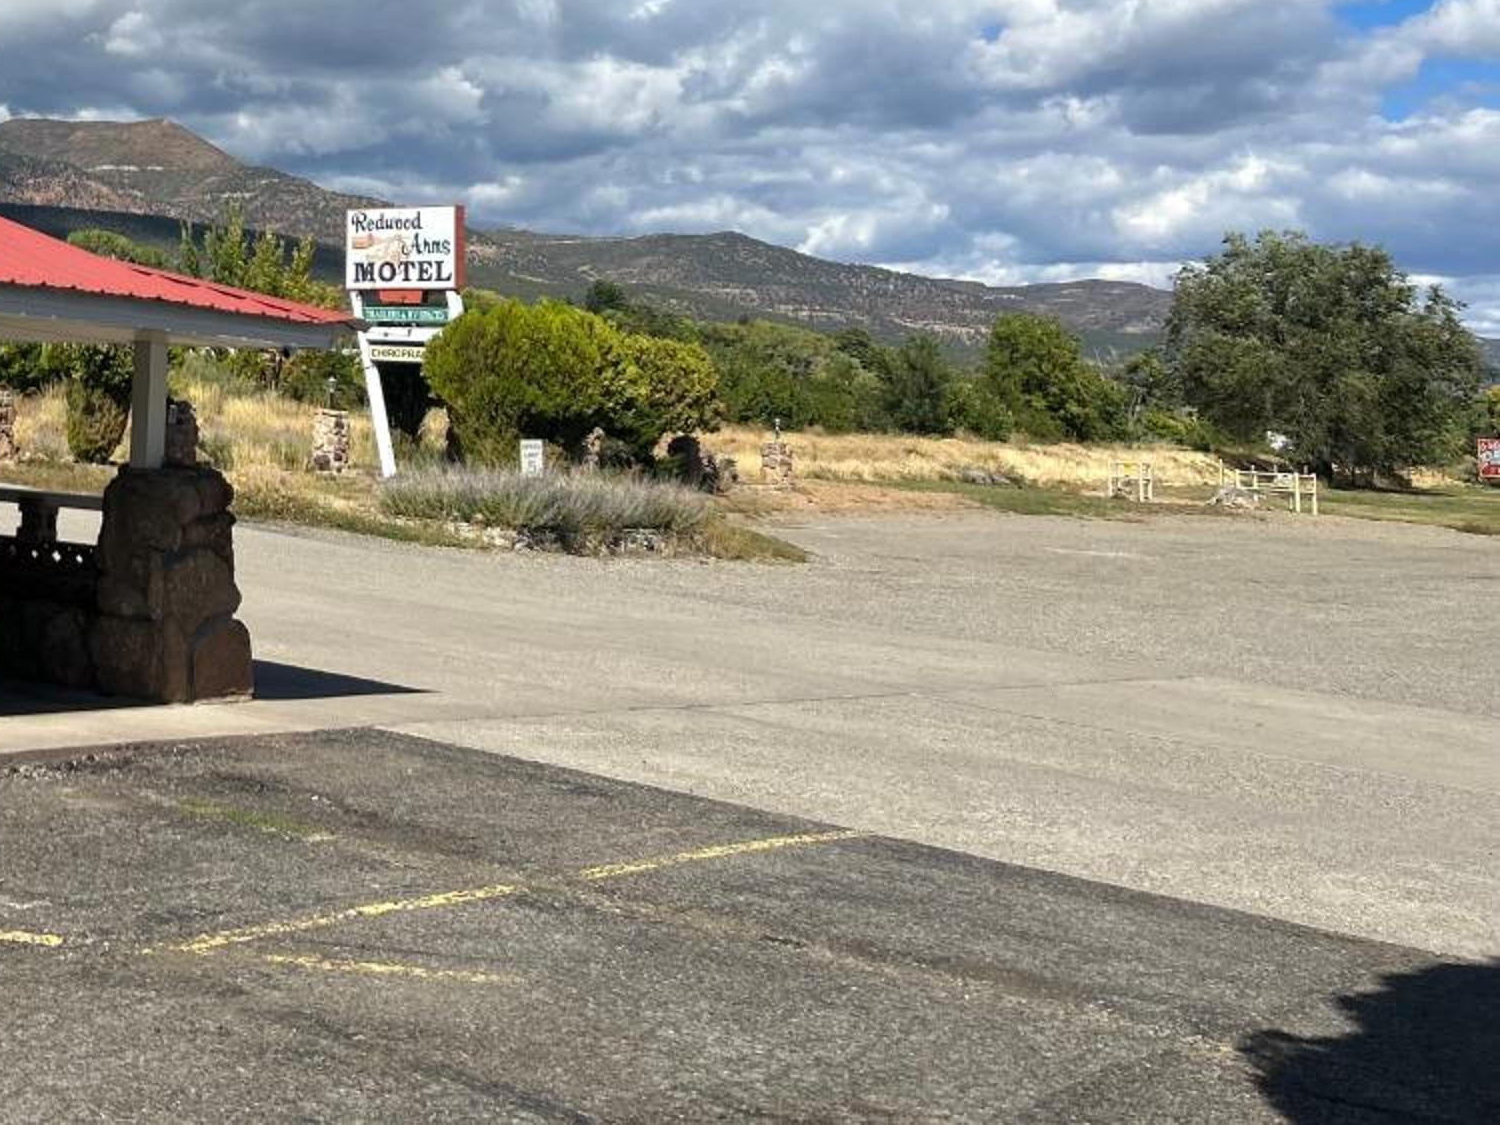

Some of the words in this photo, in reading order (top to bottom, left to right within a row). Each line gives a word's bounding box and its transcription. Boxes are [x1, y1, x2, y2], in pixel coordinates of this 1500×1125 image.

[351, 211, 423, 233] Redwood
[401, 232, 451, 256] Arms
[353, 260, 453, 284] MOTEL
